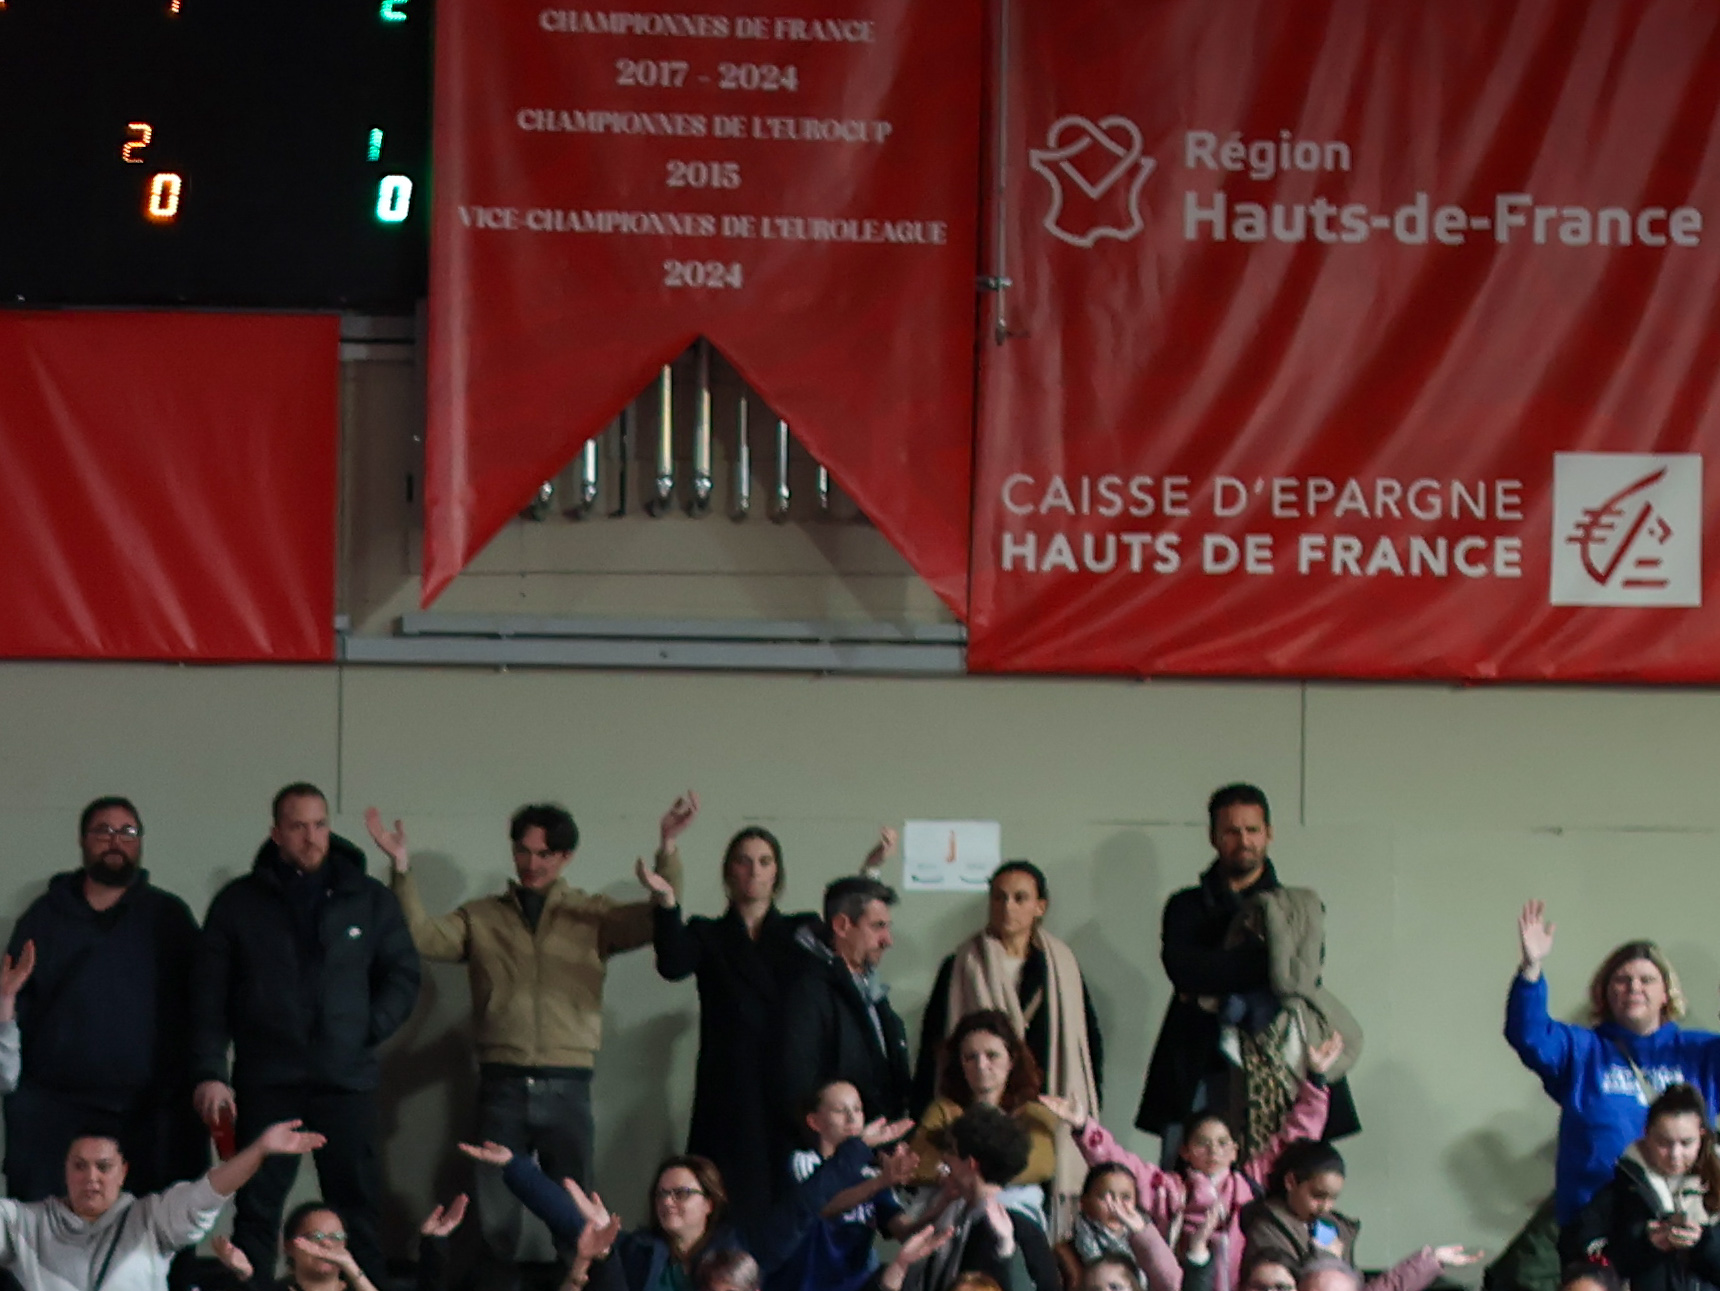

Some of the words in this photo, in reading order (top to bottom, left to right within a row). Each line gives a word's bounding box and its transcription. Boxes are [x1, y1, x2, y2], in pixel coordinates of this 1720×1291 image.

[540, 10, 728, 38] CHAMPIONNES
[736, 16, 769, 39] DE
[775, 19, 875, 42] FRANCE
[616, 60, 690, 88] 2017
[718, 63, 799, 92] 2024
[123, 122, 153, 164] 2
[517, 109, 705, 137] CHAMPIONNES
[713, 115, 747, 139] DE
[752, 116, 893, 143] L'EUROCUP
[667, 161, 742, 189] 2015
[1185, 130, 1351, 181] Région
[148, 173, 181, 218] 0
[378, 174, 413, 222] 0
[722, 214, 756, 238] DE
[1183, 192, 1703, 247] Hauts-de-France
[663, 260, 744, 289] 2024
[1001, 473, 1191, 517] CAISSE
[1214, 478, 1524, 521] D'EPARGNE
[1002, 532, 1182, 574] HAUTS
[1203, 536, 1275, 575] DE
[1299, 536, 1524, 578] FRANCE
